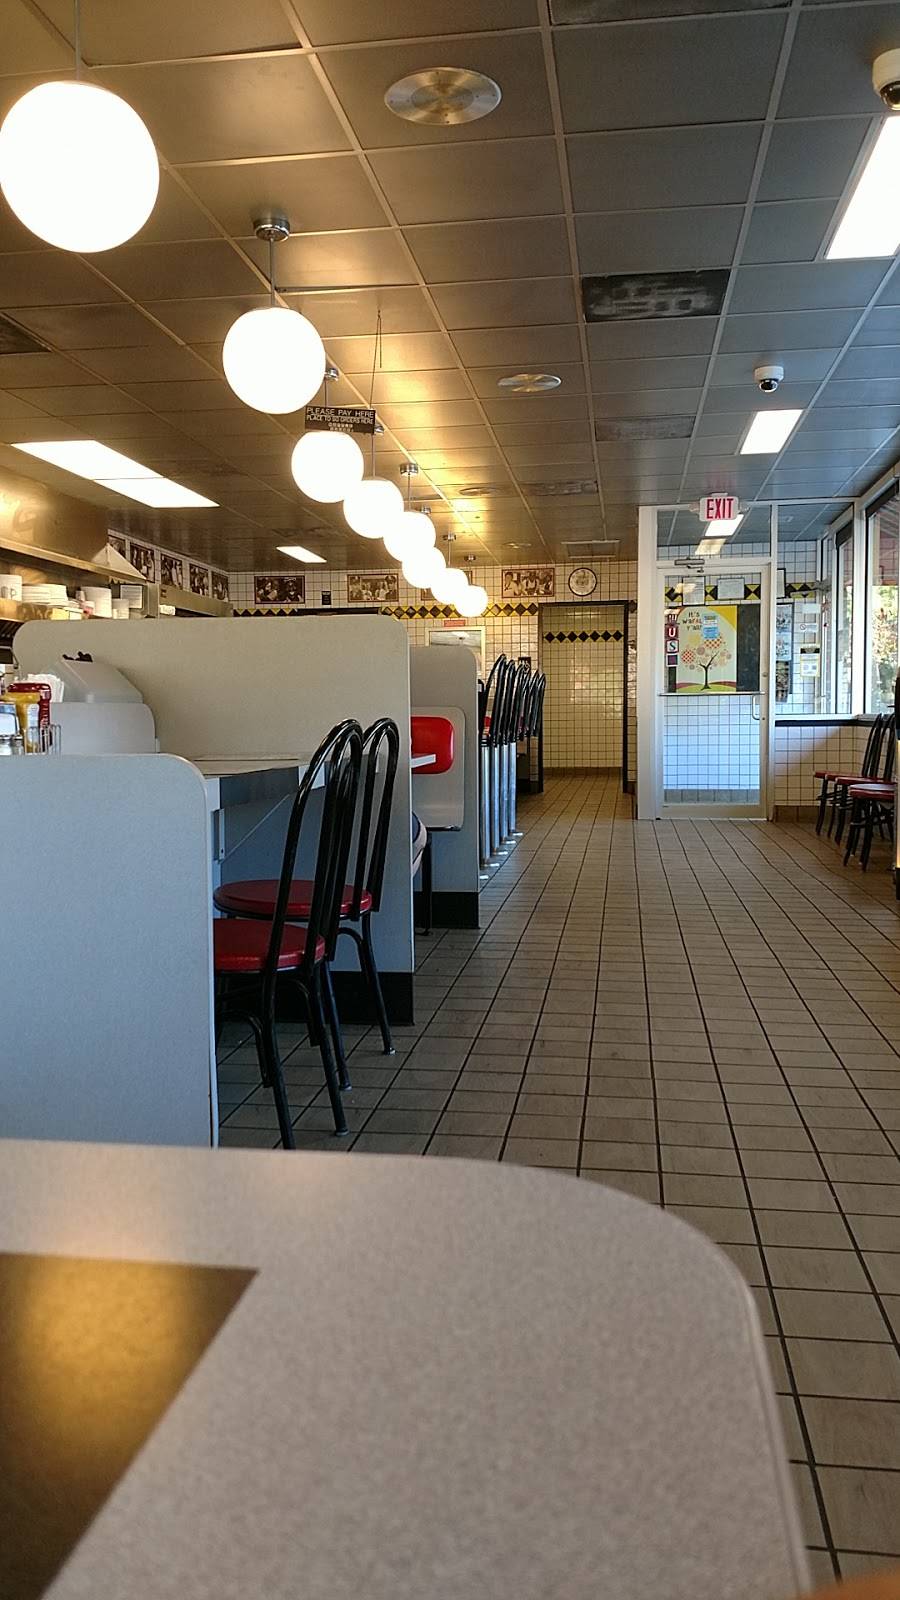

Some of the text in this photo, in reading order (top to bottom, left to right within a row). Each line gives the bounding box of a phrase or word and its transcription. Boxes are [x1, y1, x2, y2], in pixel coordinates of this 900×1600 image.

[306, 407, 335, 416] PLEASE
[354, 410, 374, 418] HERE
[706, 498, 734, 519] EXIT
